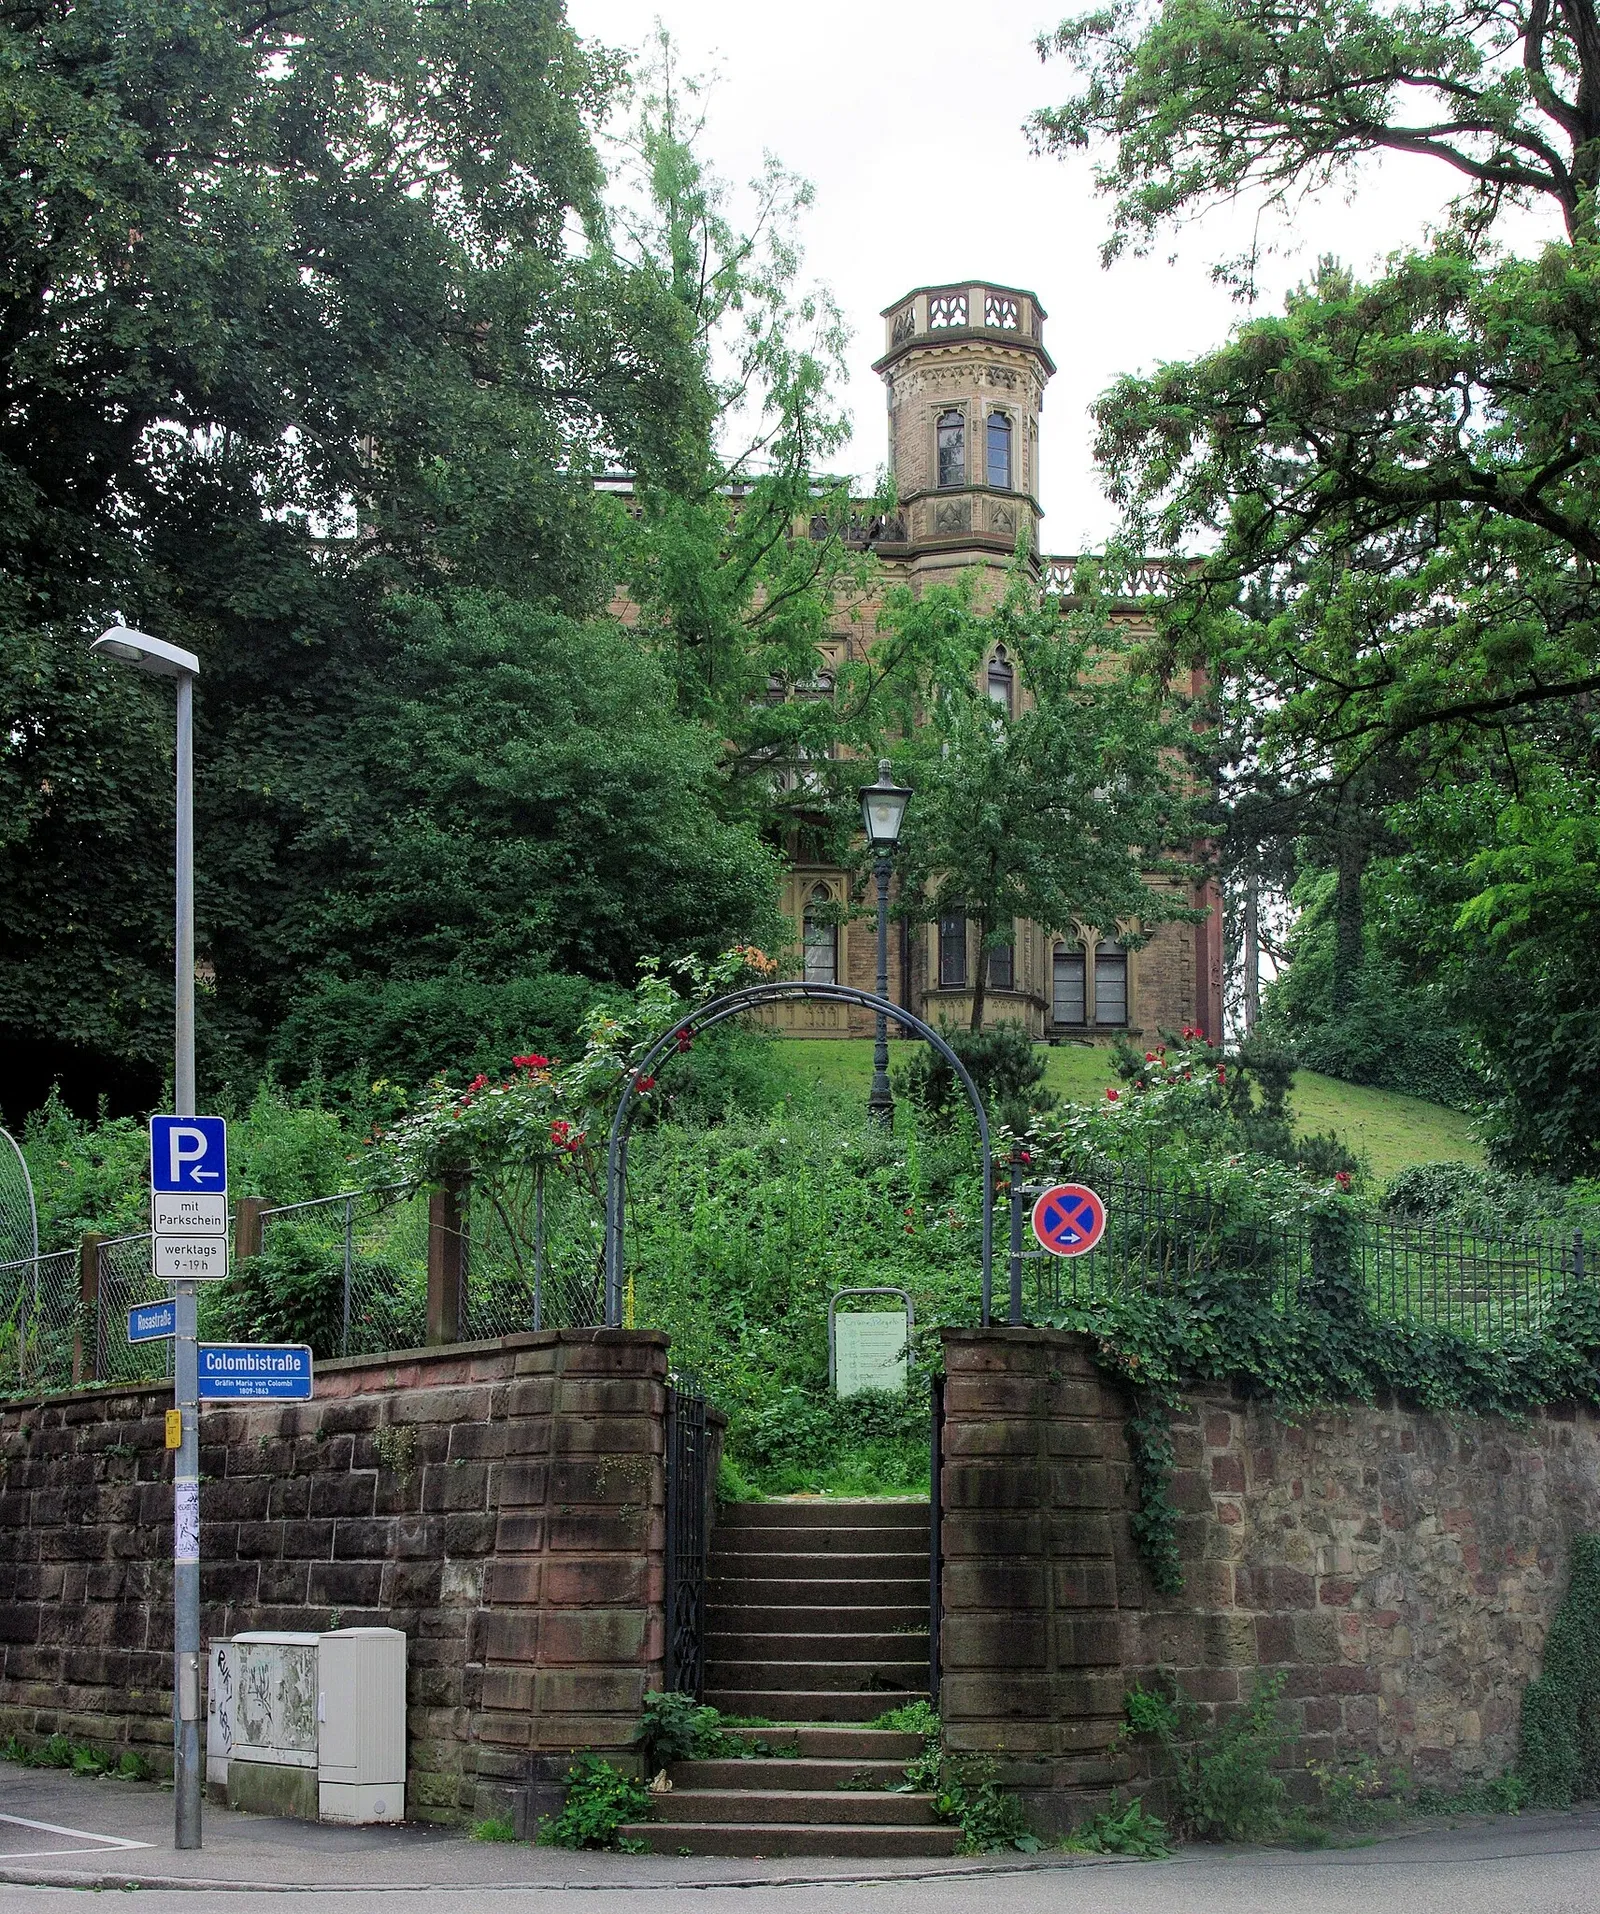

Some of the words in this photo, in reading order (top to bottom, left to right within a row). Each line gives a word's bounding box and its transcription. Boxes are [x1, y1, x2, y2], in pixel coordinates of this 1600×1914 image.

[169, 1126, 208, 1182] P
[181, 1201, 199, 1211] mit
[159, 1214, 221, 1225] Parkschein
[165, 1244, 217, 1257] werktags
[137, 1309, 172, 1331] Rosastraße
[206, 1353, 301, 1371] Colombistraße
[214, 1379, 235, 1387] Gräfin
[235, 1379, 253, 1387] Maria
[267, 1379, 293, 1387] Colombi
